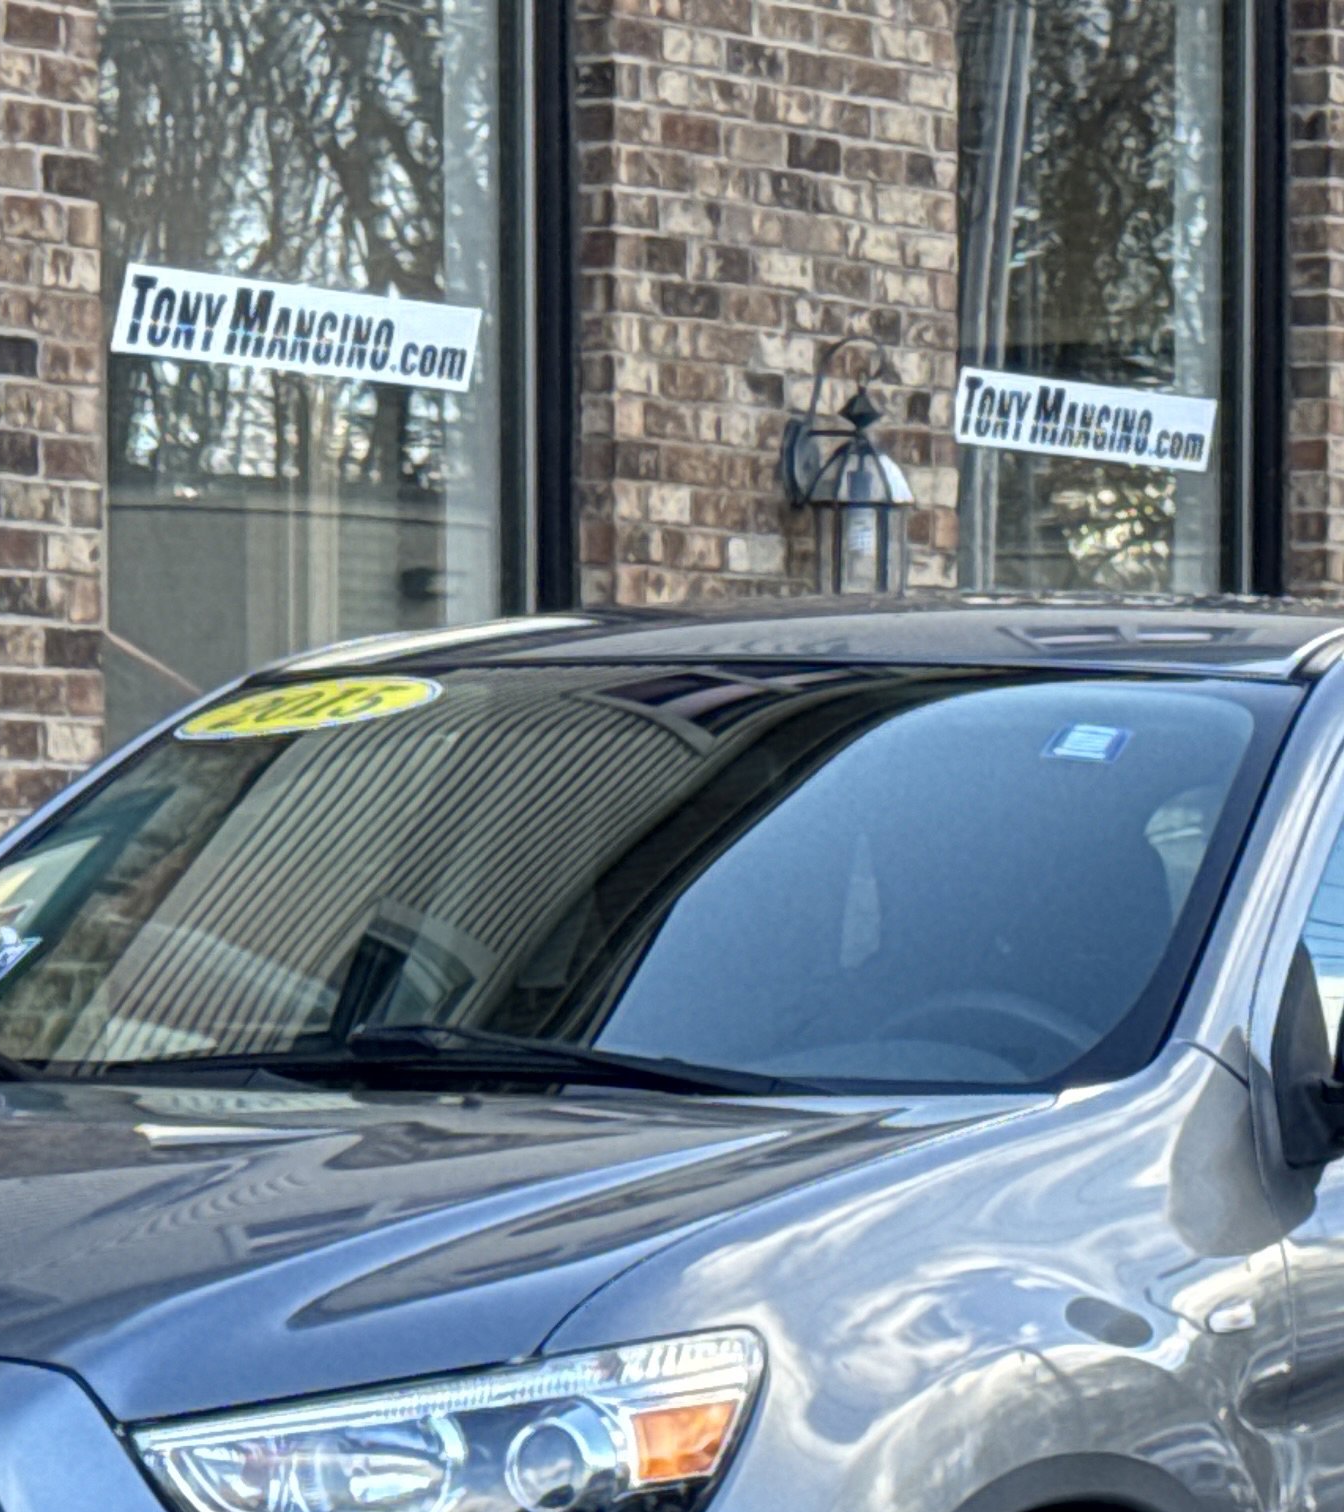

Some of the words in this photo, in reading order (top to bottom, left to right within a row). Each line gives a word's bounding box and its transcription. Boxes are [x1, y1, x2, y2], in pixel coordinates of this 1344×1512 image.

[126, 275, 227, 353] TONY
[224, 288, 467, 382] MANGINO.com
[960, 376, 1032, 442] TONY
[206, 684, 411, 731] 2015
